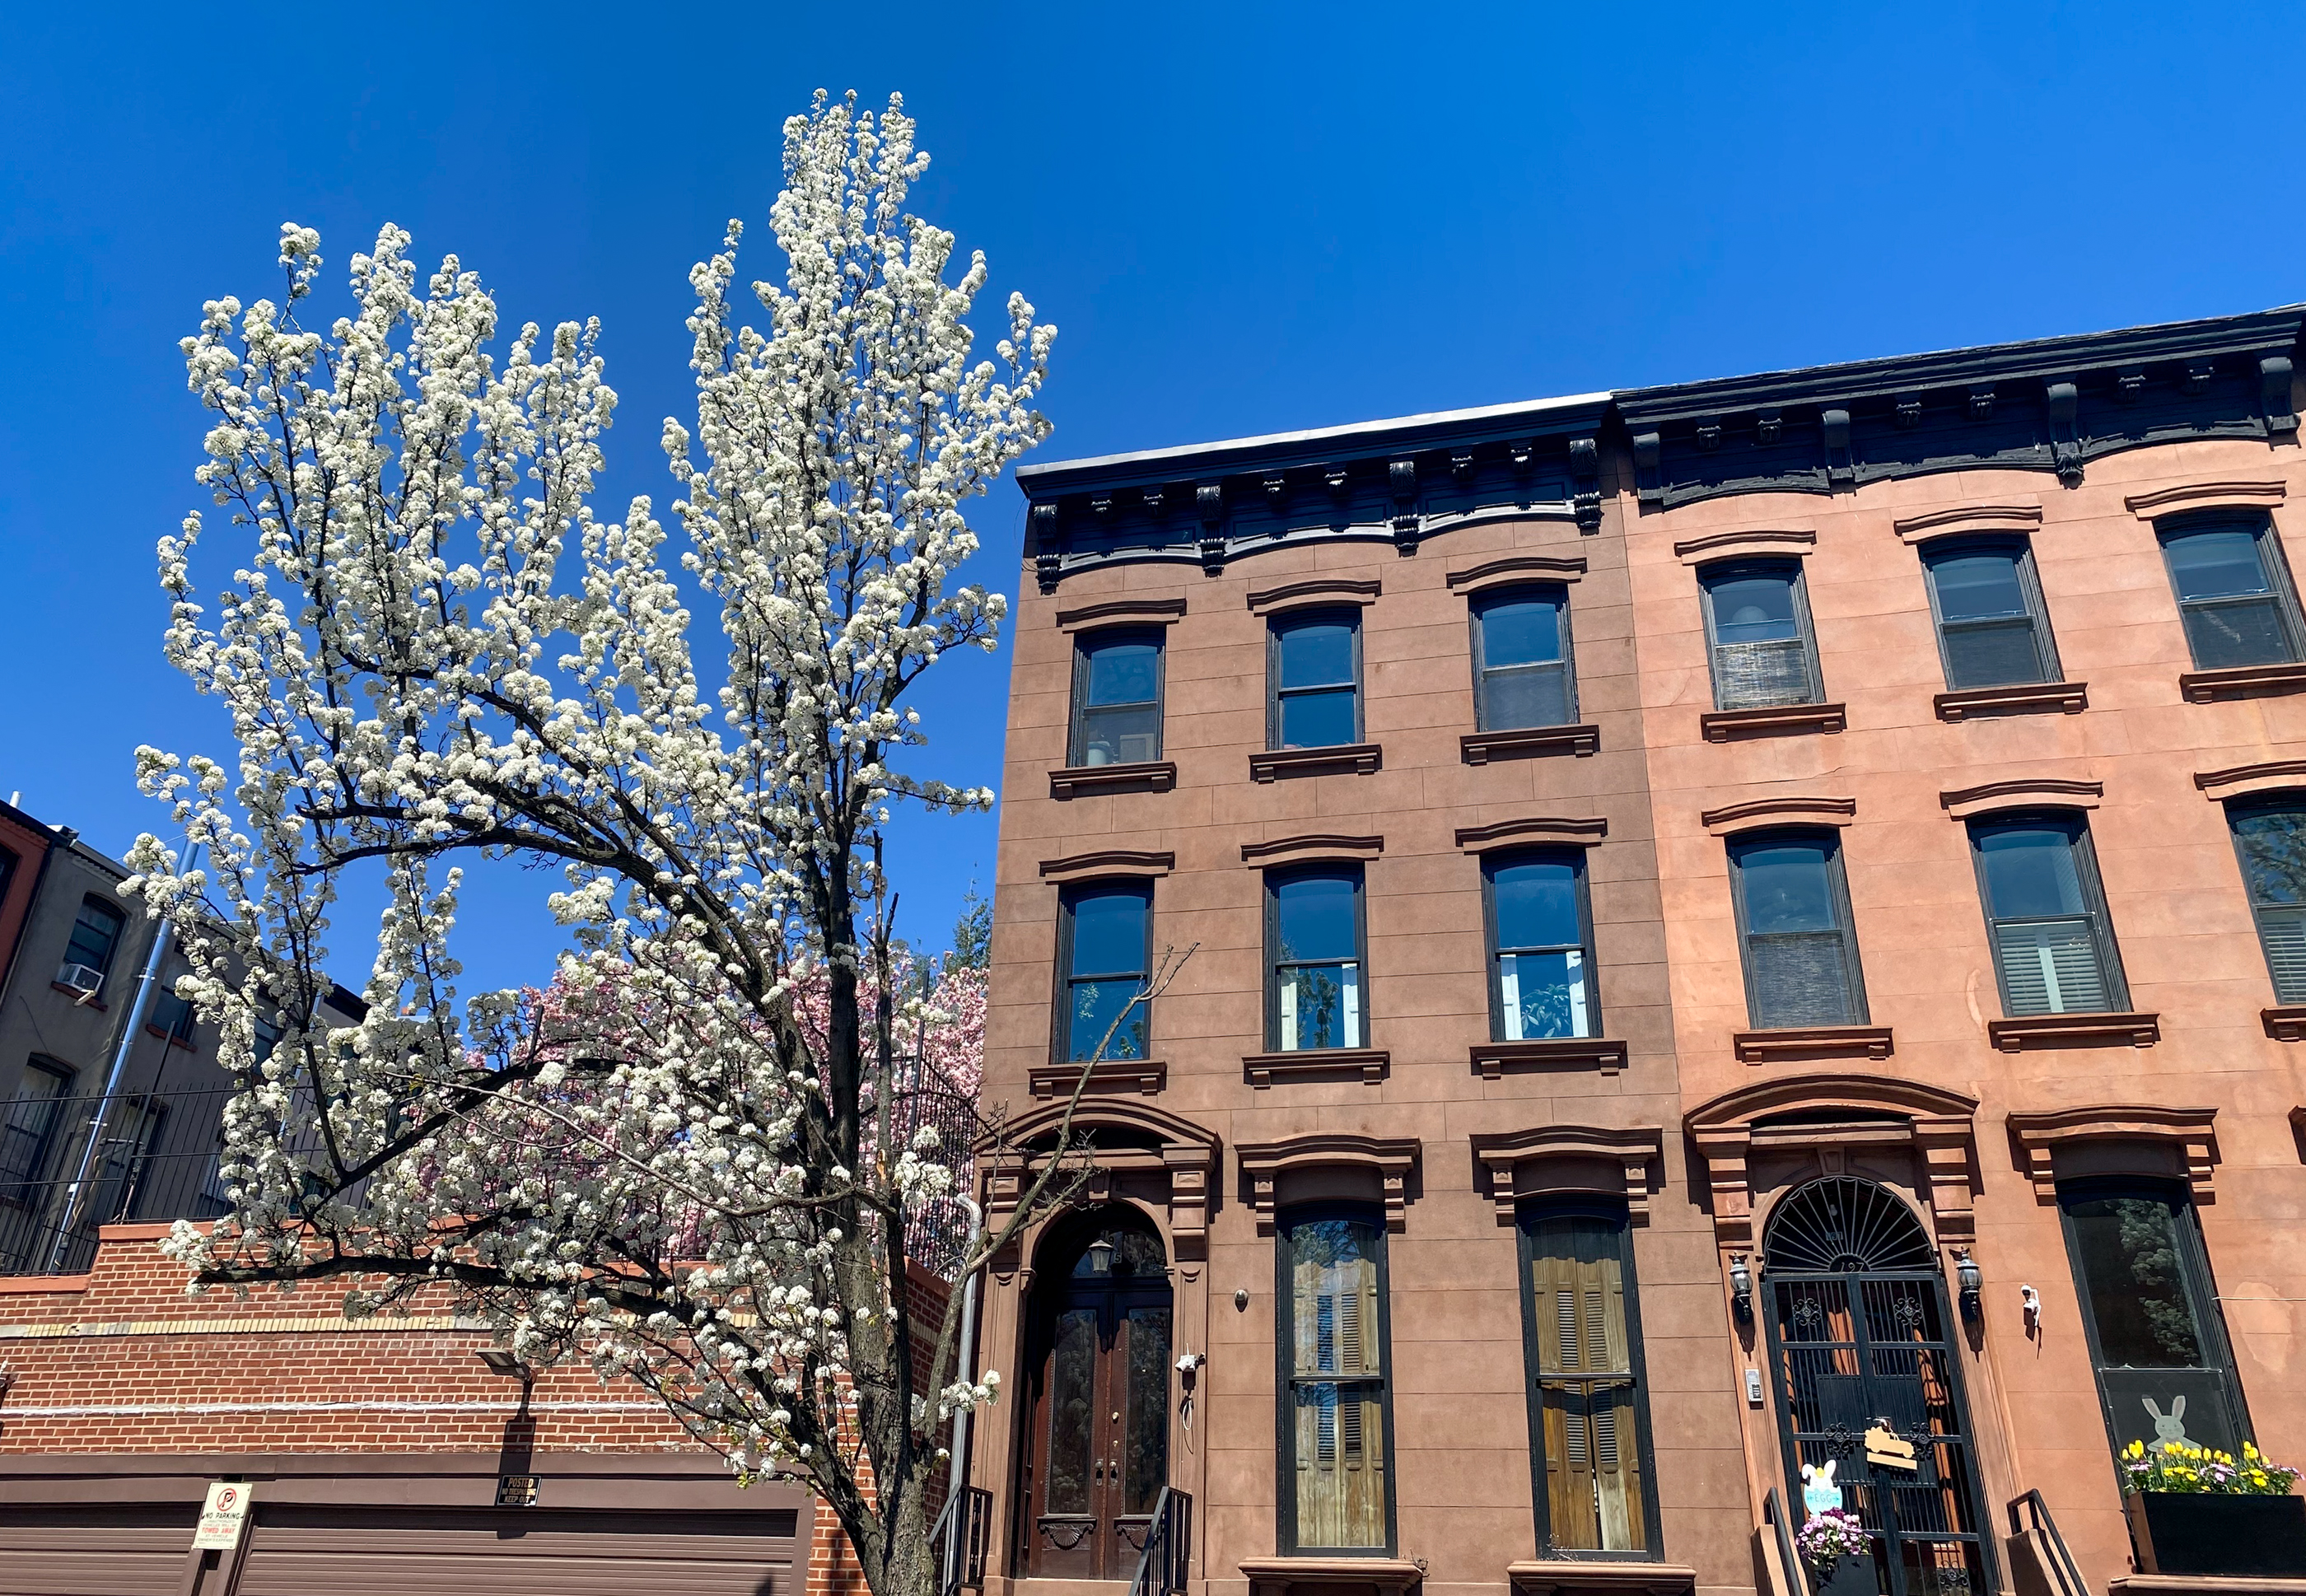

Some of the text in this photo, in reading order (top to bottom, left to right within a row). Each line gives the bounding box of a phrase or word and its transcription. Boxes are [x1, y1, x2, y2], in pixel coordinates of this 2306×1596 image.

[1841, 1262, 1865, 1273] 197
[507, 1478, 534, 1488] POSTED
[1814, 1494, 1832, 1503] EGG
